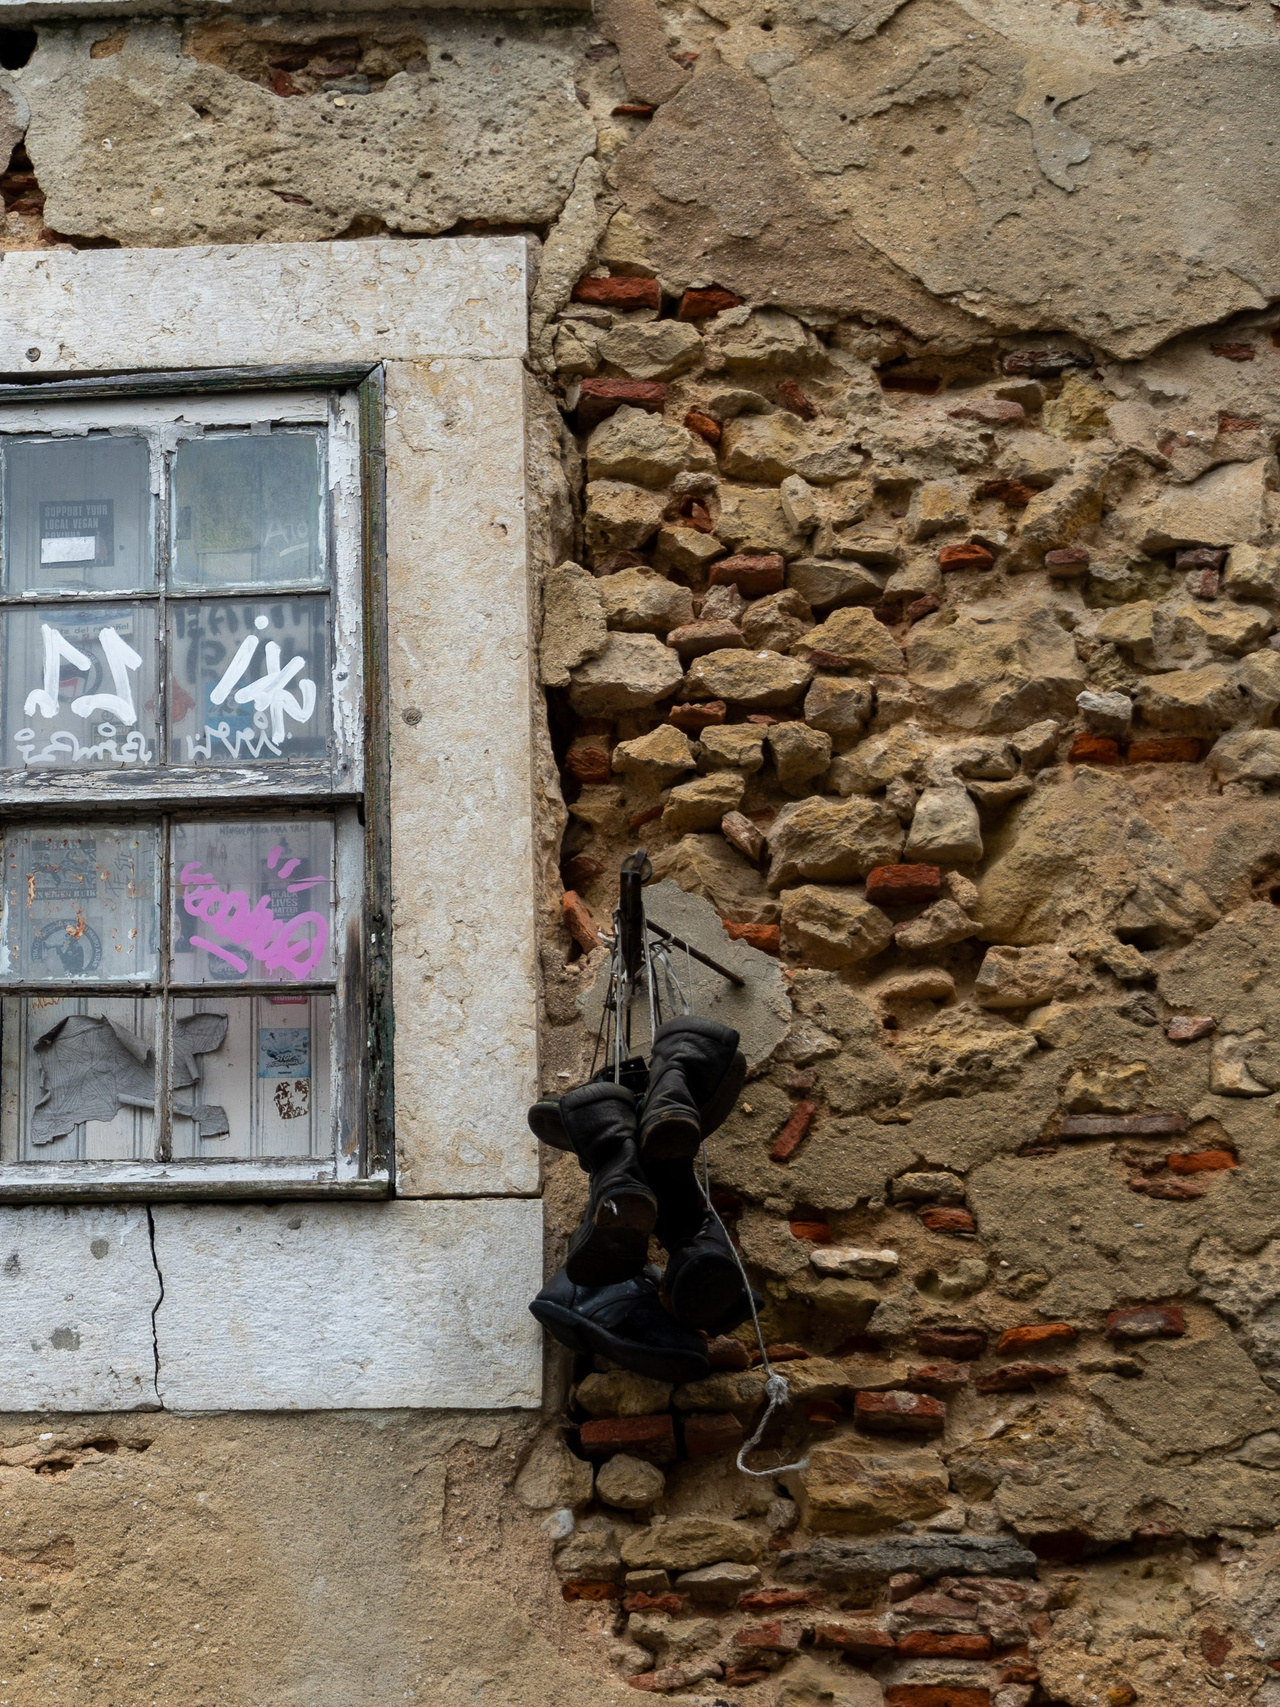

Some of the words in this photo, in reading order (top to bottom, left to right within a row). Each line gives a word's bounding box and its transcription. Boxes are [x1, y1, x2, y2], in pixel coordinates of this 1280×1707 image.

[44, 506, 83, 517] SUPPORT
[86, 504, 108, 516] YOUR
[45, 518, 69, 530] LOCAL
[72, 517, 99, 529] VEGAN
[74, 626, 89, 634] del
[271, 890, 299, 899] BLACK
[271, 898, 299, 908] LIVES
[271, 906, 299, 914] MATTER
